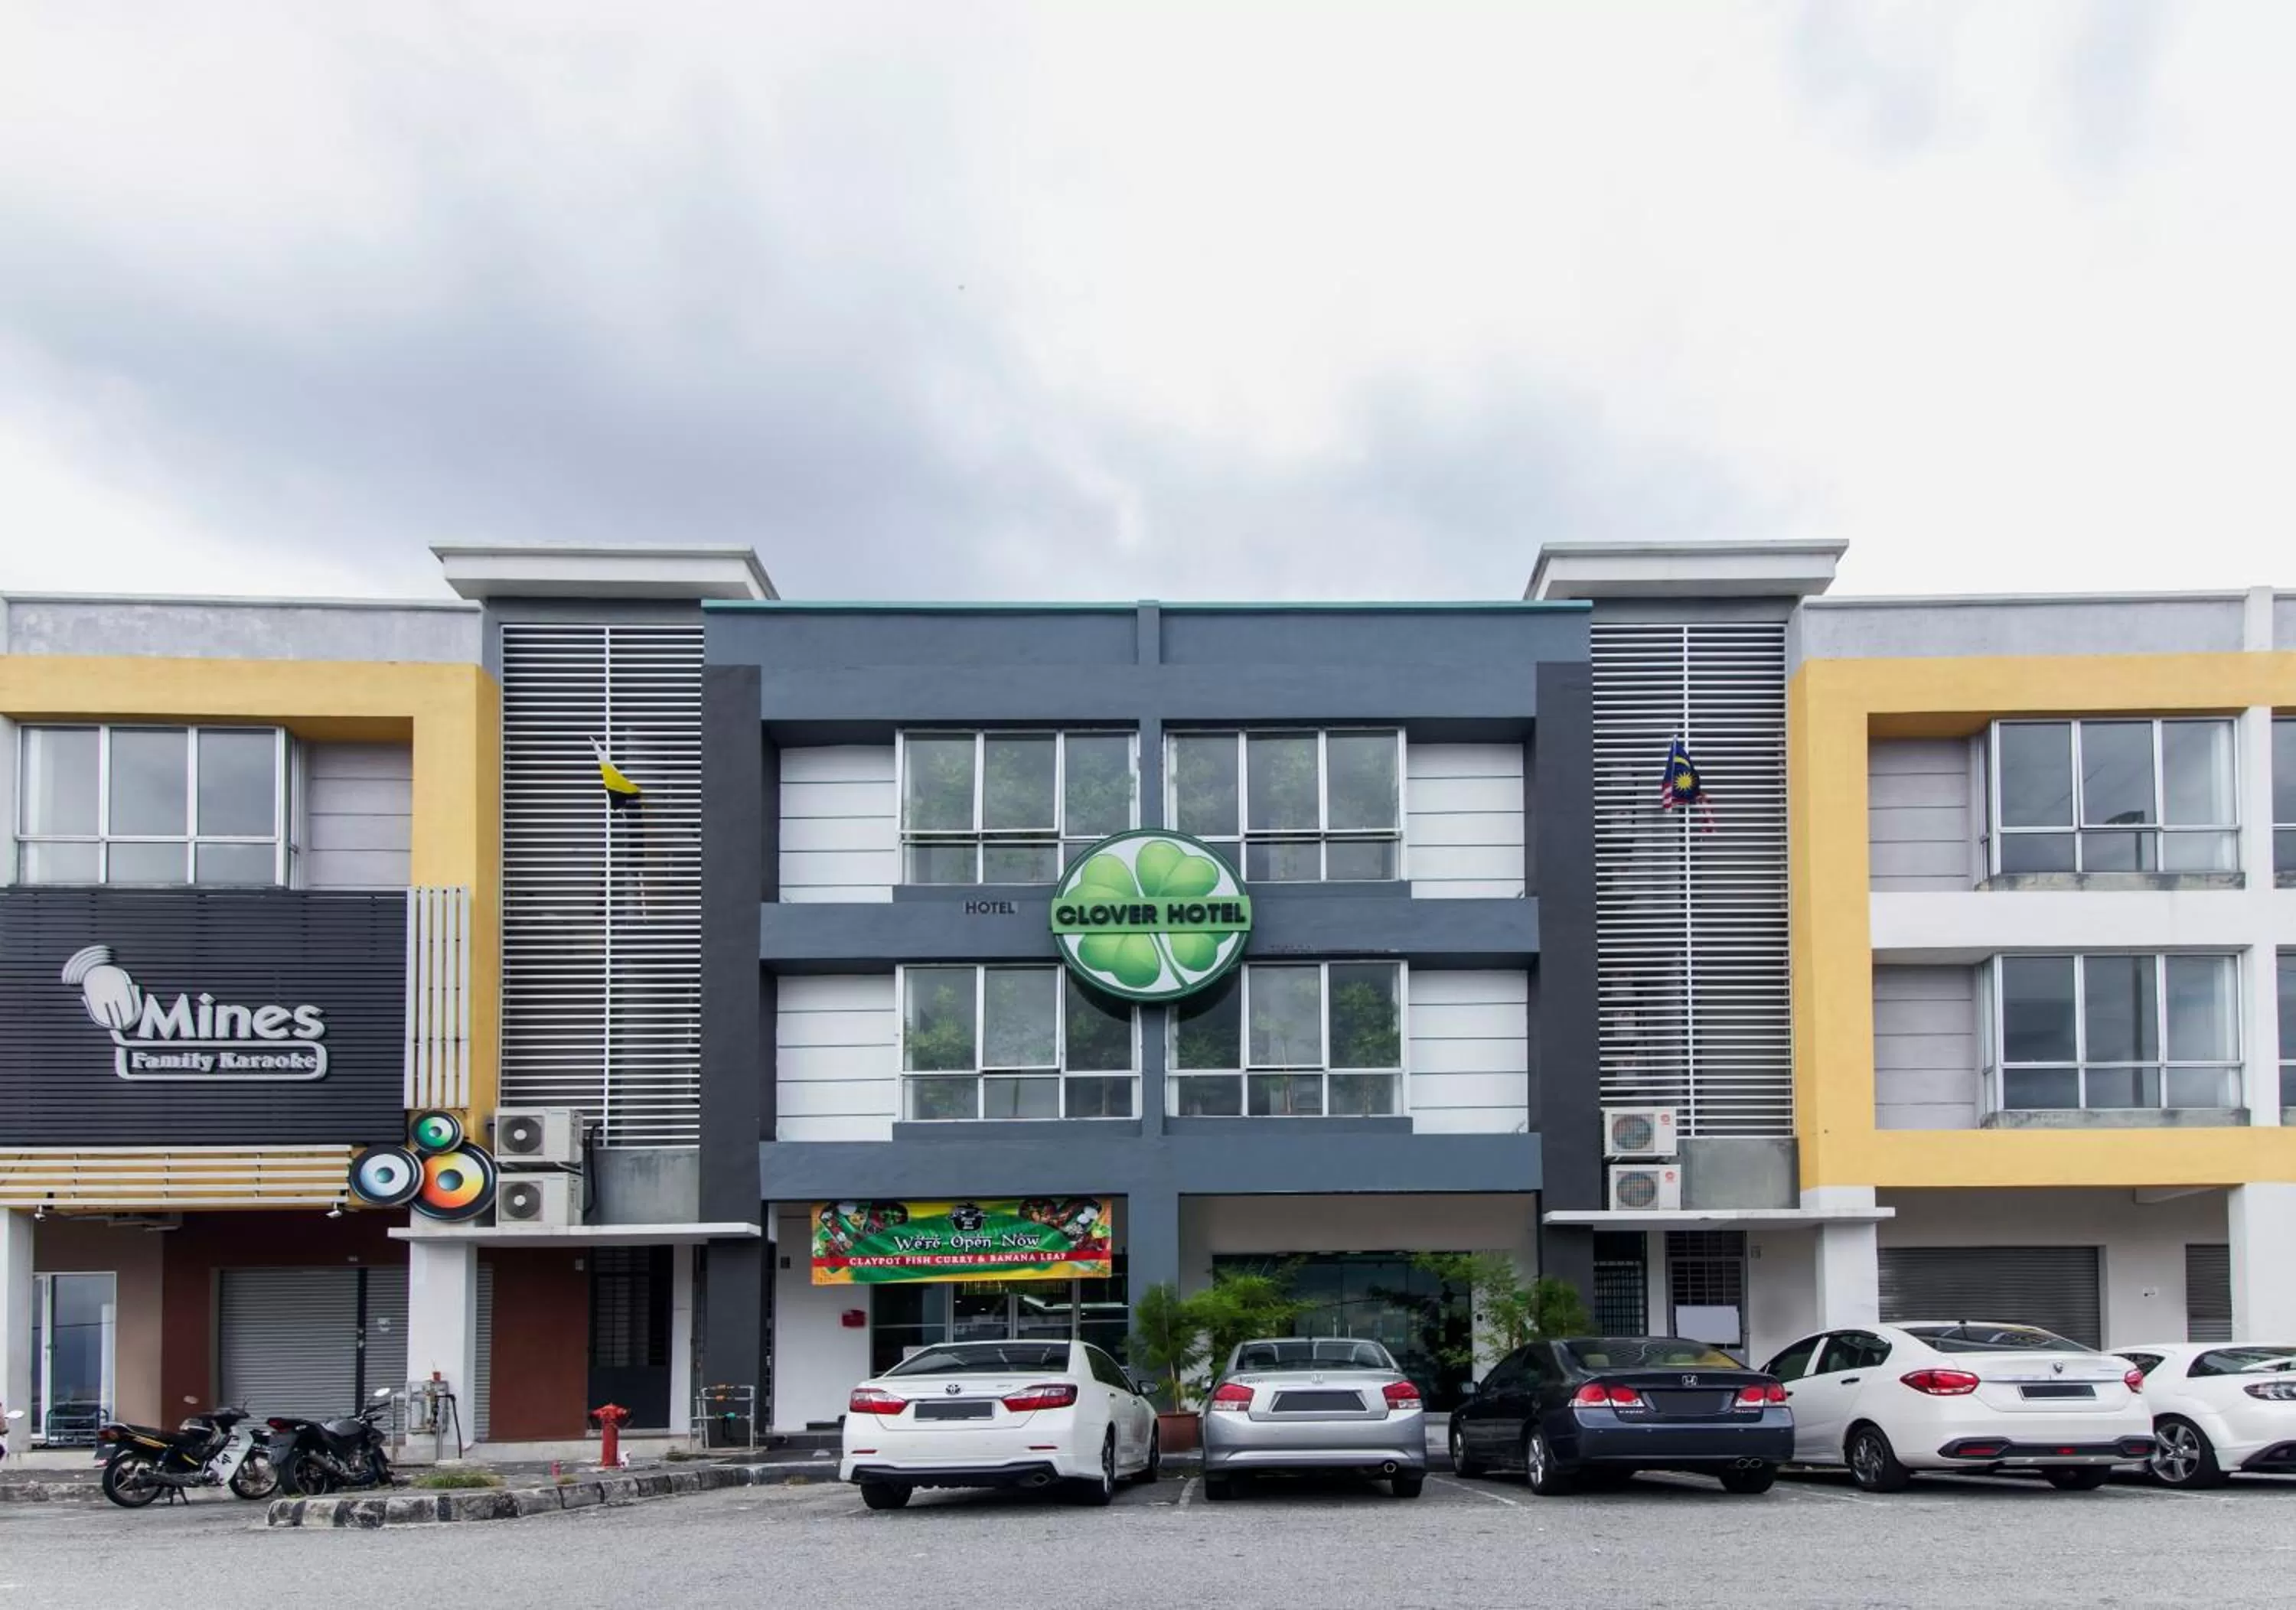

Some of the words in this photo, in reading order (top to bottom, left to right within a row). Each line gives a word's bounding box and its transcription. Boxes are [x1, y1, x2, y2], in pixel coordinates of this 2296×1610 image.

[965, 901, 1016, 914] HOTEL
[1055, 904, 1157, 926] CLOVER
[1167, 902, 1247, 924] HOTEL
[137, 992, 325, 1040] Mines
[131, 1052, 215, 1071] Family
[219, 1052, 318, 1069] Karaoke
[951, 1234, 992, 1252] Open
[1001, 1234, 1039, 1247] Now
[849, 1256, 901, 1266] CLAYPOT
[905, 1256, 931, 1265] FISH
[935, 1255, 973, 1264] CURRY
[990, 1254, 1036, 1263] BANANA
[1040, 1253, 1066, 1261] LEAF
